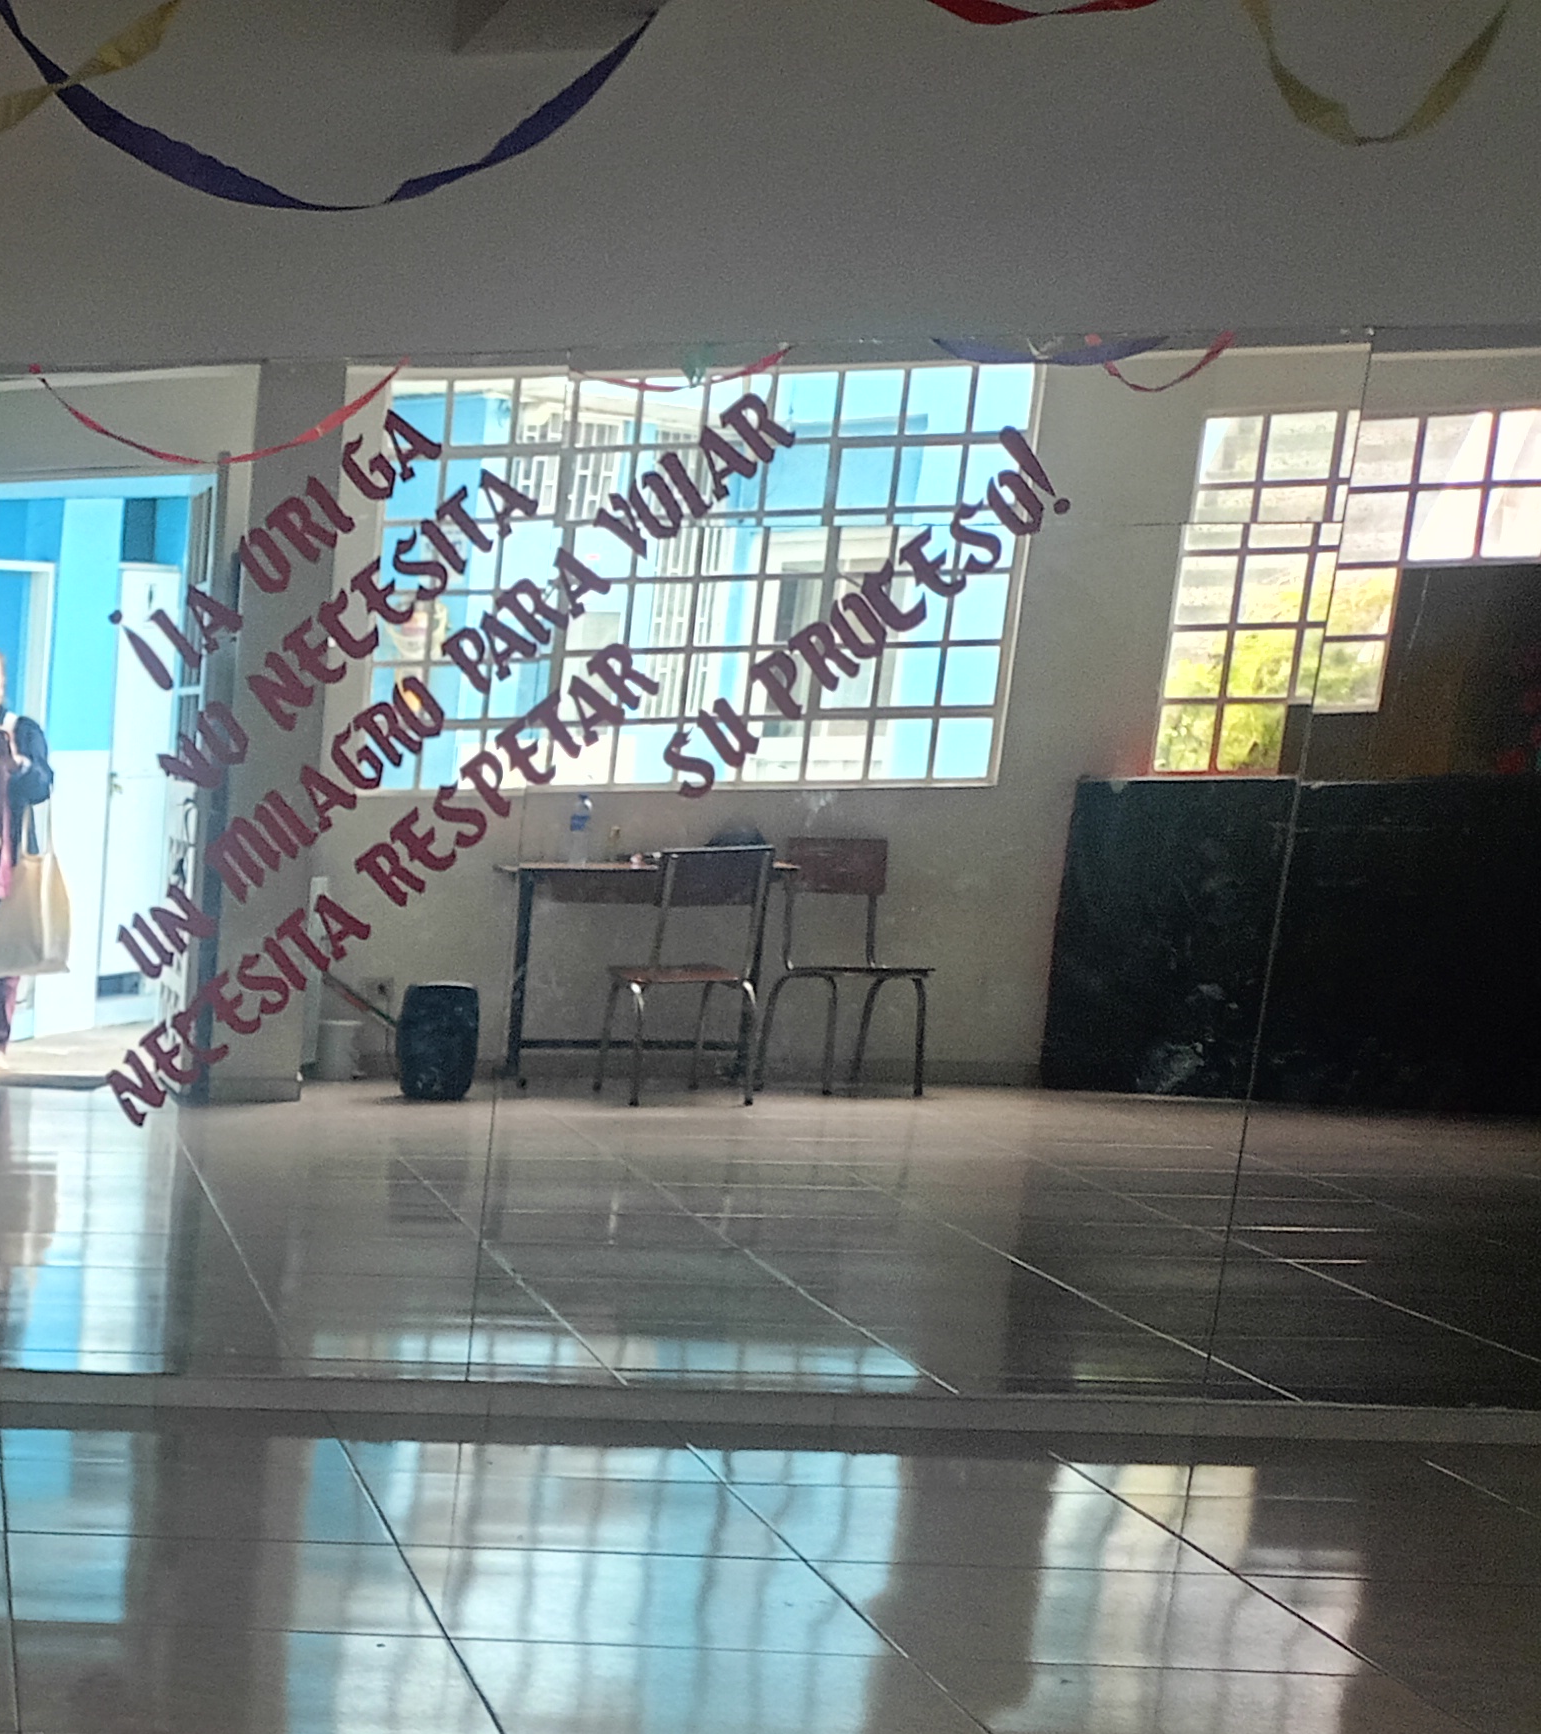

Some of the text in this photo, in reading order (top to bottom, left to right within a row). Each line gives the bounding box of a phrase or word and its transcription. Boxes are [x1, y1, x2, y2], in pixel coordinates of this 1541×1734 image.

[117, 885, 217, 979] UN
[441, 547, 612, 693] PARA
[158, 468, 538, 789] NO NECESITA
[663, 425, 1071, 799] SU PROCESO!
[106, 643, 660, 1128] NECESITA RESPETAR
